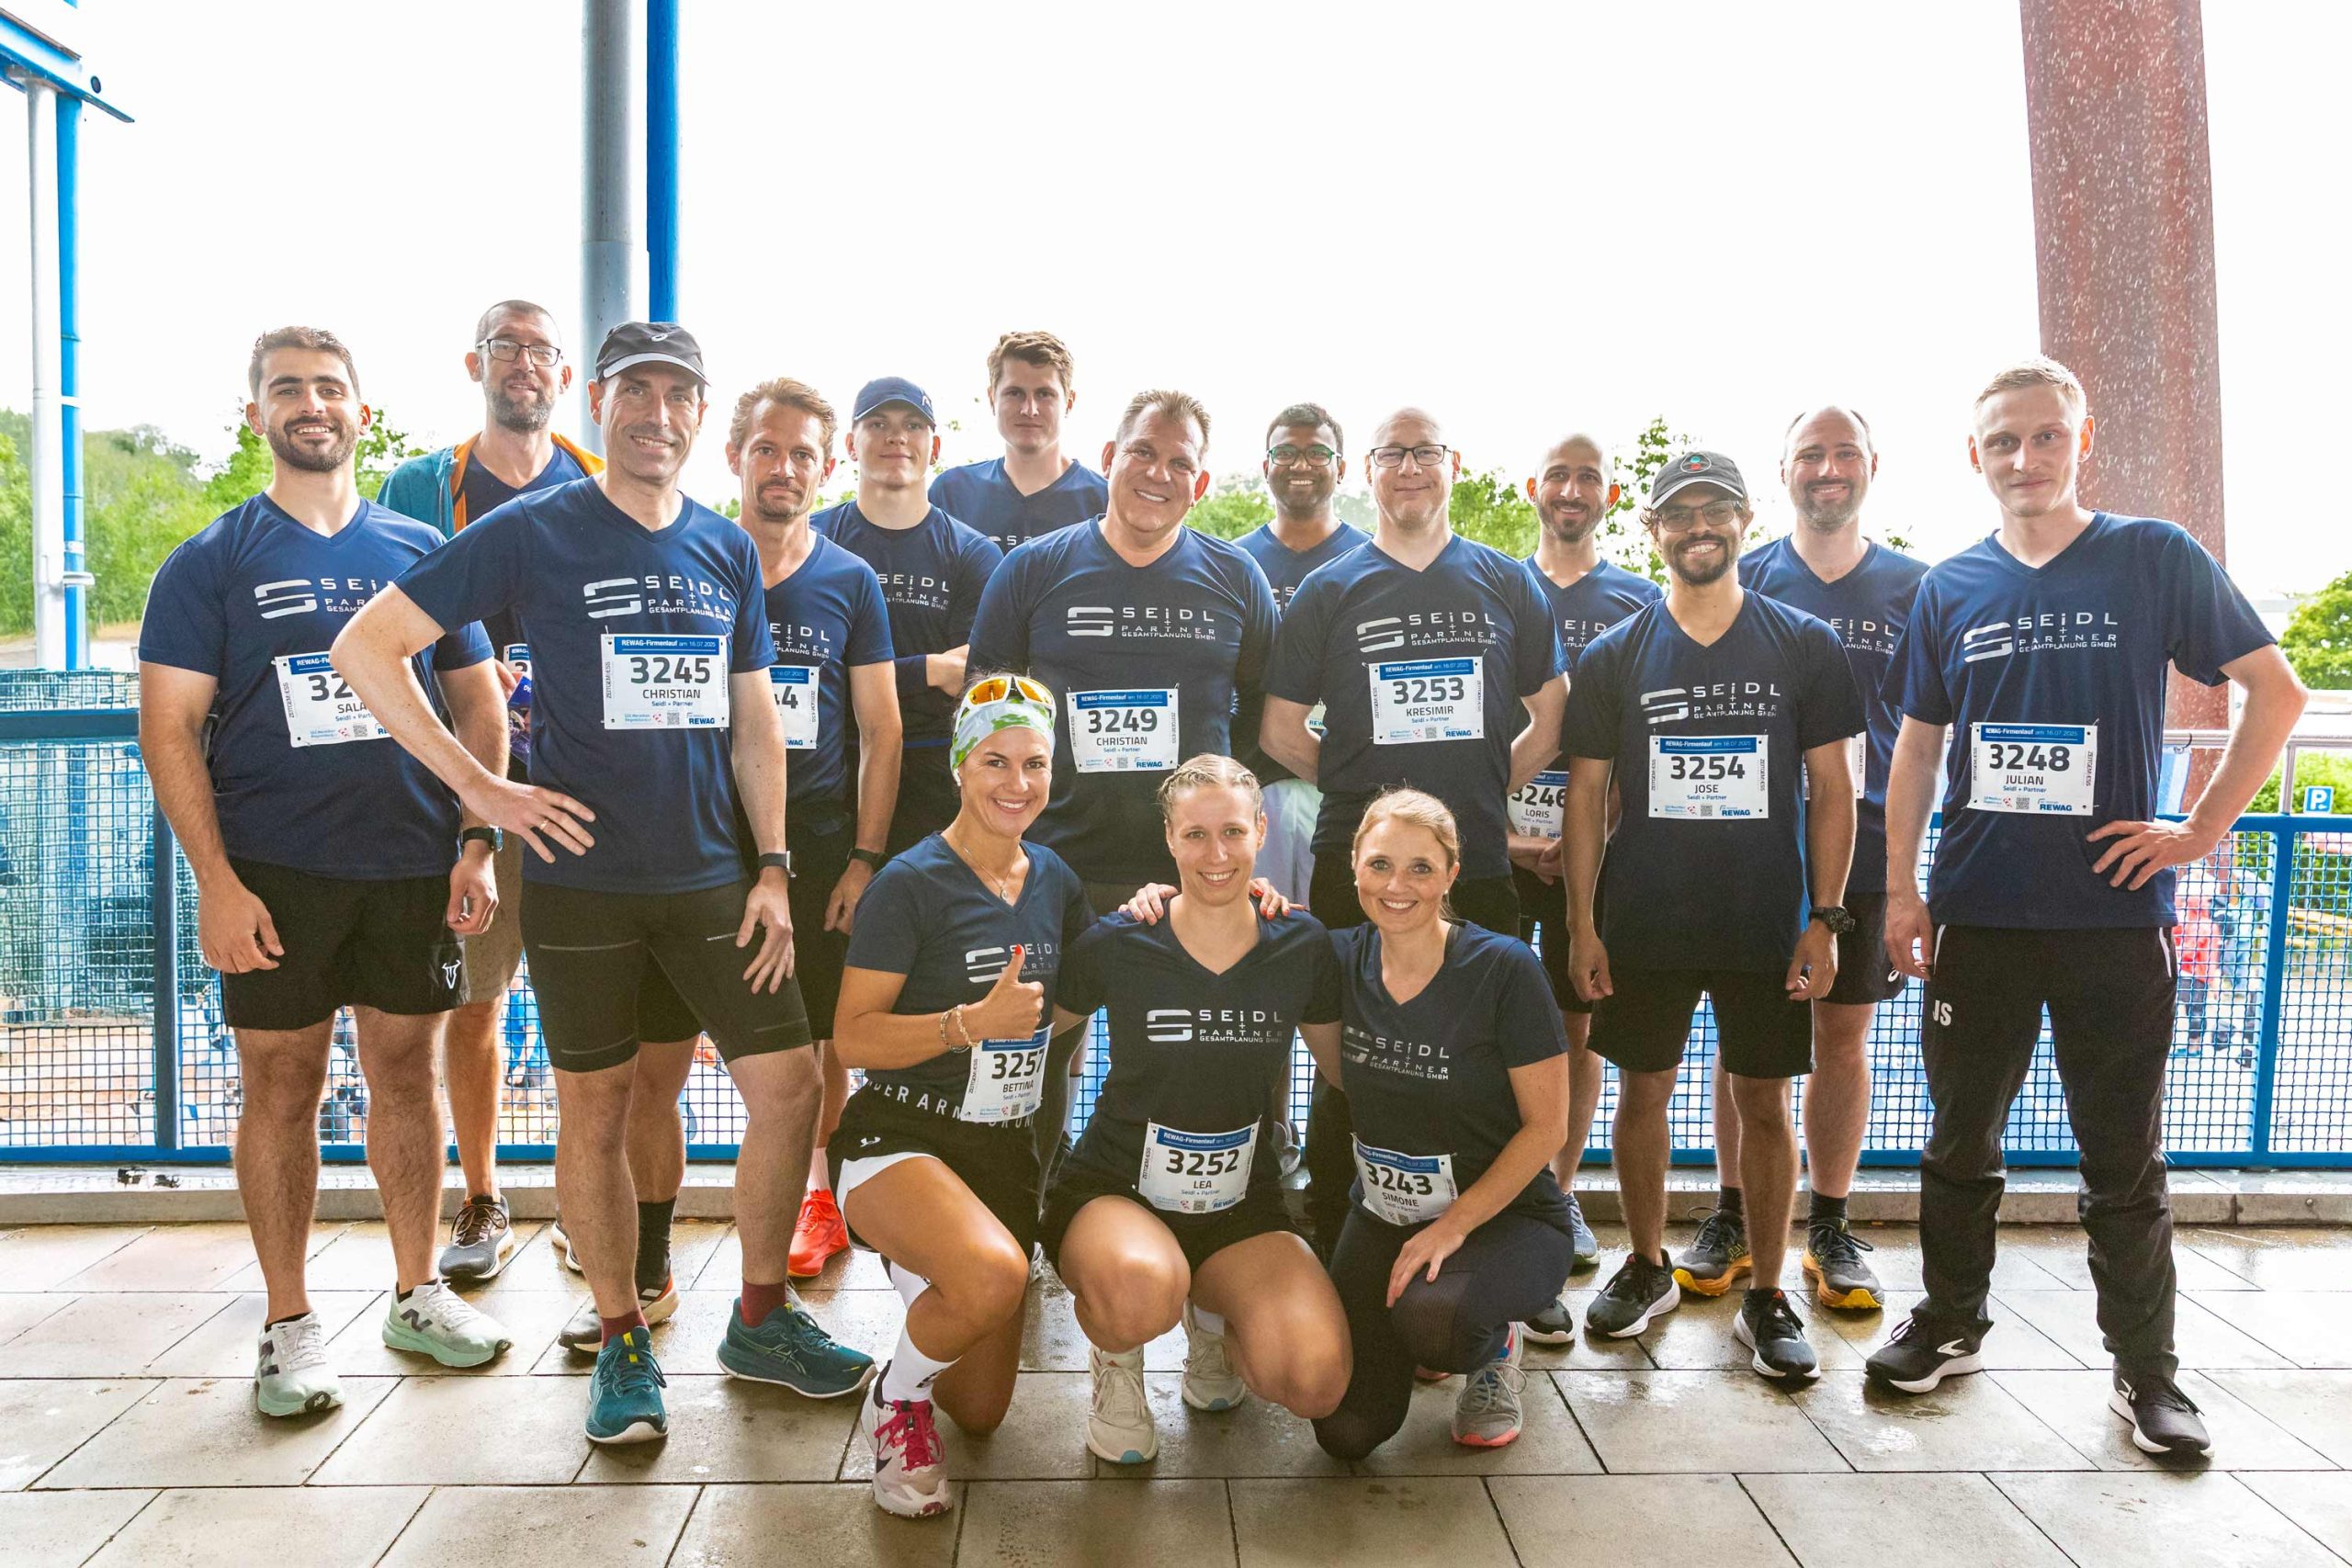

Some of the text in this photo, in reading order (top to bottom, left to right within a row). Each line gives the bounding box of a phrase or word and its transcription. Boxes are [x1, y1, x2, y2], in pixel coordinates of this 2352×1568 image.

[648, 599, 730, 616] PARTNER
[770, 623, 830, 641] EiDL
[1122, 626, 1215, 635] PARTNER
[1830, 618, 1894, 637] EiDL
[1411, 630, 1497, 639] PARTNER
[2019, 634, 2117, 646] PARTNER
[774, 641, 829, 654] RTNER
[1411, 637, 1476, 646] GESAMTPLANUNG
[1848, 637, 1894, 649] TNER
[776, 647, 809, 655] PLANUNG
[630, 657, 710, 684] 3245
[308, 674, 353, 701] 32
[1393, 677, 1464, 705] 3253
[642, 689, 701, 699] CHRISTIAN
[1406, 705, 1453, 716] KRESIMIR
[1694, 703, 1777, 713] PARTNER
[1088, 709, 1158, 733] 3249
[1097, 737, 1148, 746] CHRISTIAN
[1989, 744, 2070, 772] 3248
[1670, 756, 1745, 780] 3254
[2006, 774, 2043, 785] JULIAN
[1695, 784, 1719, 794] JOSE
[2311, 790, 2327, 809] P
[1525, 808, 1550, 818] LORIS
[1200, 1029, 1283, 1037] PARTNER
[991, 1047, 1045, 1079] 3257
[1372, 1055, 1448, 1074] PARTNER
[1003, 1080, 1034, 1092] BETTINA
[1166, 1149, 1240, 1176] 3252
[1365, 1162, 1432, 1195] 3243
[1193, 1180, 1212, 1190] LEA
[1213, 1198, 1236, 1209] REWAG
[1383, 1192, 1419, 1207] SIMONE
